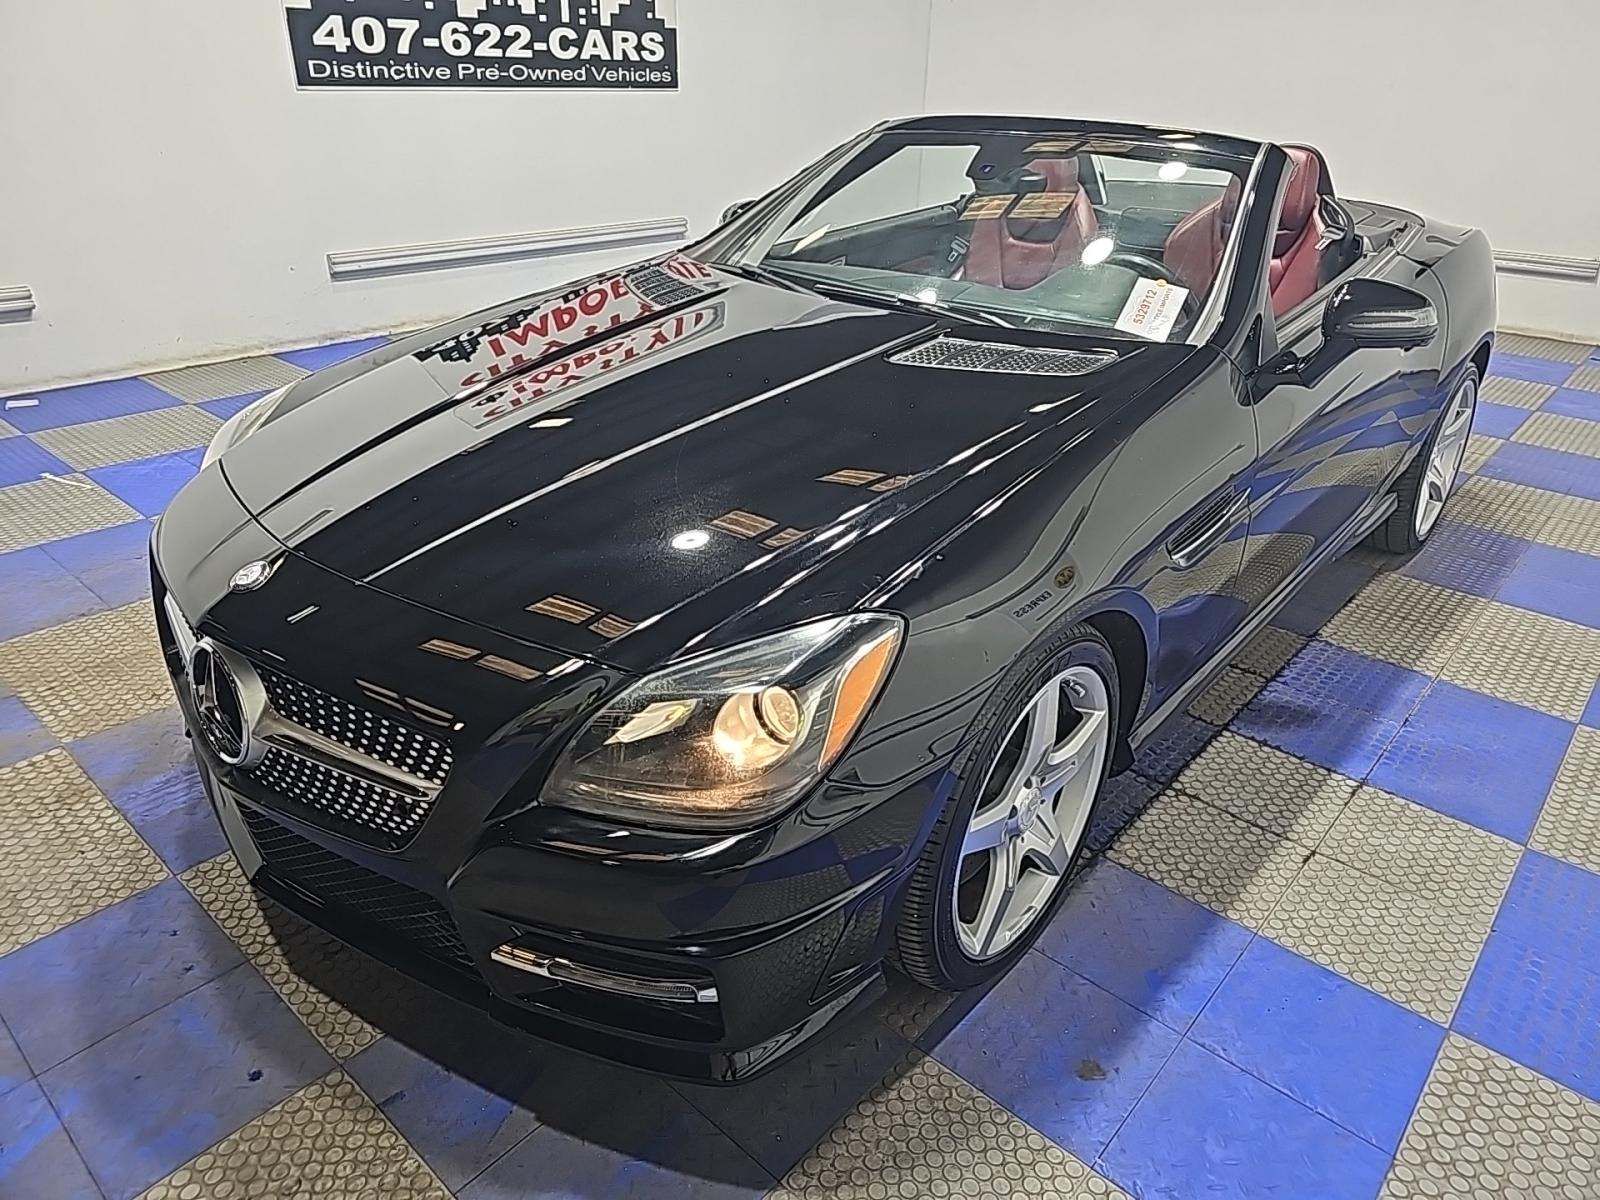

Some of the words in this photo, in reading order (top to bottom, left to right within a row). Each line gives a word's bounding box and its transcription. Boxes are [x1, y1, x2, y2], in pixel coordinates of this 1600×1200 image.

[312, 14, 666, 62] 407-622-CARS
[307, 59, 451, 81] Distinctive
[458, 63, 587, 82] Pre-Owned
[595, 66, 672, 83] Vehicles
[1133, 289, 1158, 325] 5329712
